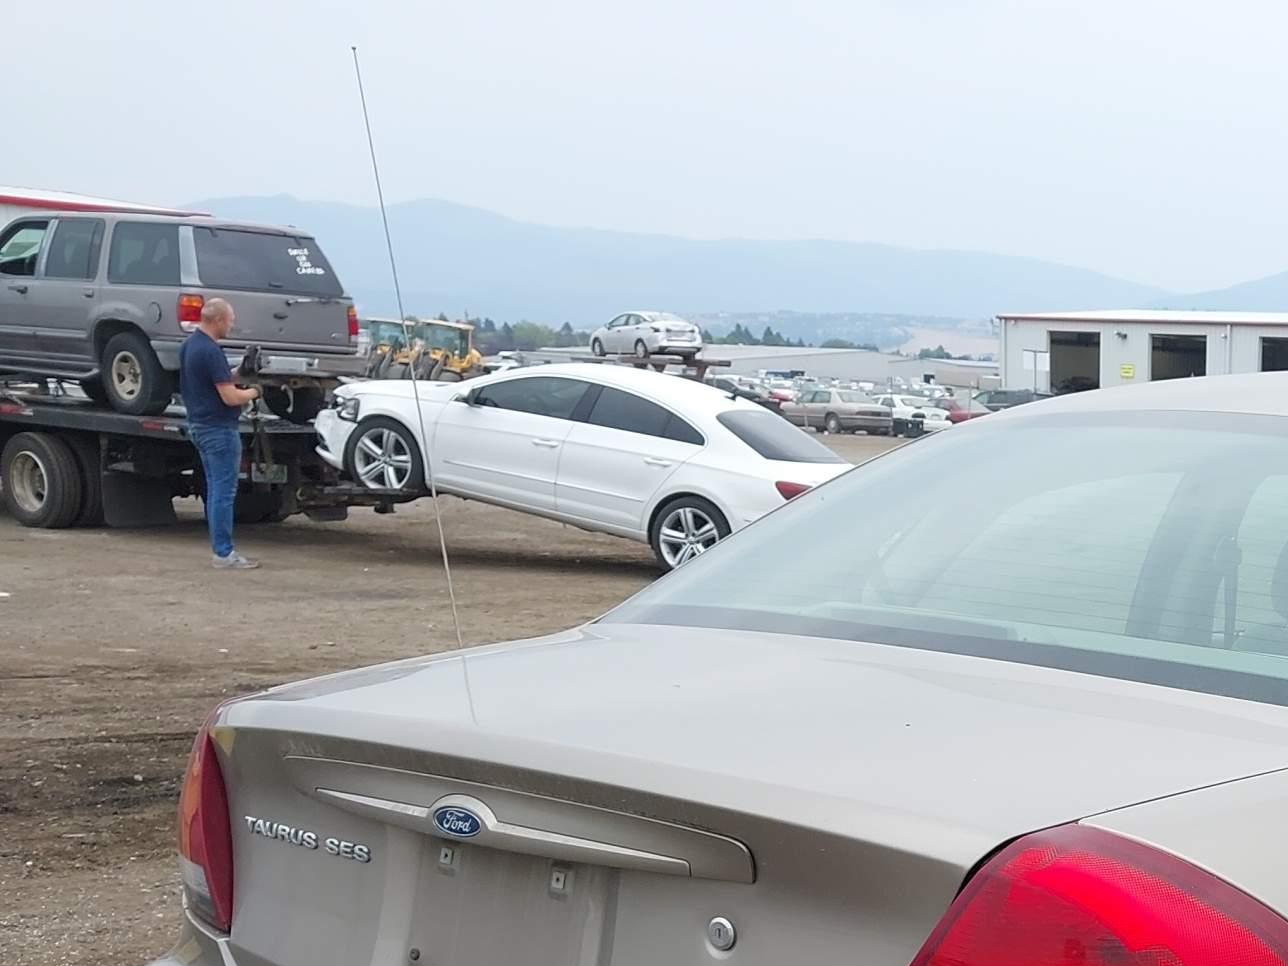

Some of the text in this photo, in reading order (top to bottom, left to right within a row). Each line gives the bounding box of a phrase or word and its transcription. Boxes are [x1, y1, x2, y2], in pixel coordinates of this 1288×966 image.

[443, 810, 472, 832] Ford
[245, 815, 372, 863] TAURUS SES
